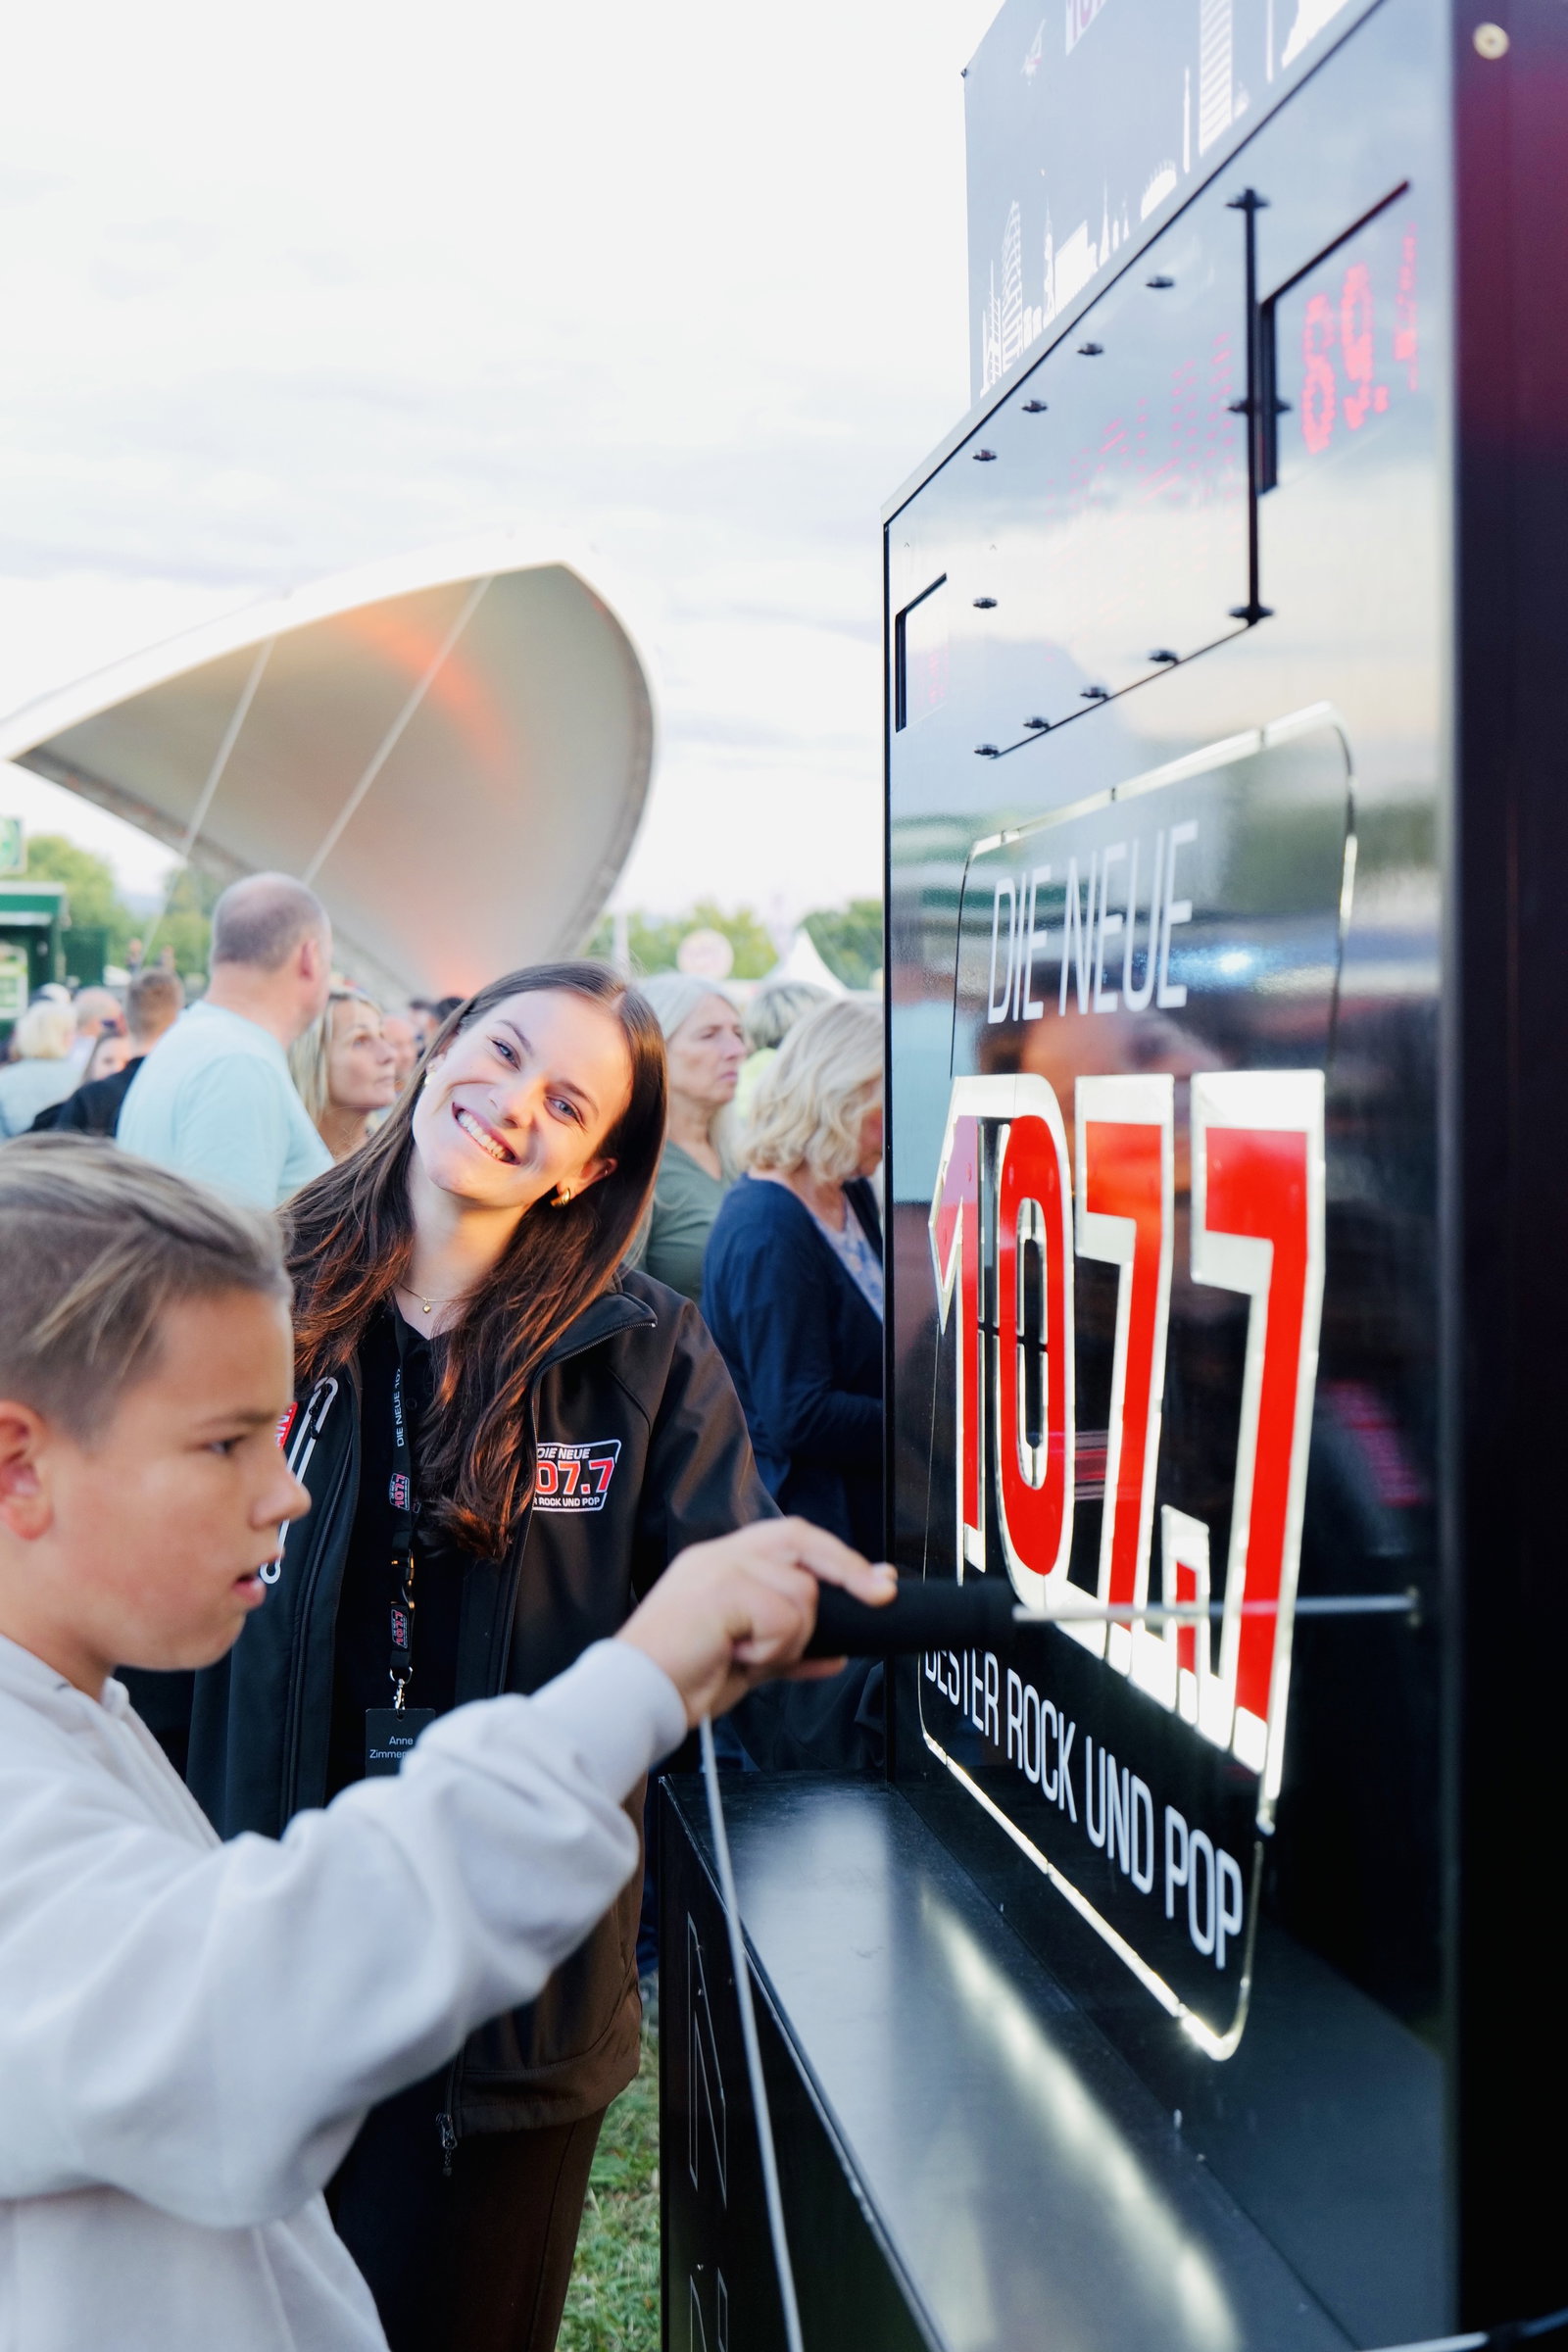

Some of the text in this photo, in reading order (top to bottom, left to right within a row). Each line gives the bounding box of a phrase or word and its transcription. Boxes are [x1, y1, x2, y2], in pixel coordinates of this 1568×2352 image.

[987, 819, 1199, 1025] DIE NEUE
[393, 1391, 403, 1425] NEUE
[396, 1426, 405, 1447] DIE
[929, 1068, 1326, 1801] 107.7
[537, 1446, 591, 1460] DIE NEUE
[535, 1456, 614, 1495] 07.7
[538, 1496, 562, 1506] ROCK
[562, 1497, 580, 1507] UND
[581, 1496, 600, 1506] POP
[389, 1736, 414, 1745] Anne
[1006, 1667, 1078, 1824] ROCK
[1085, 1735, 1154, 1895] UND
[1164, 1803, 1244, 1971] POP
